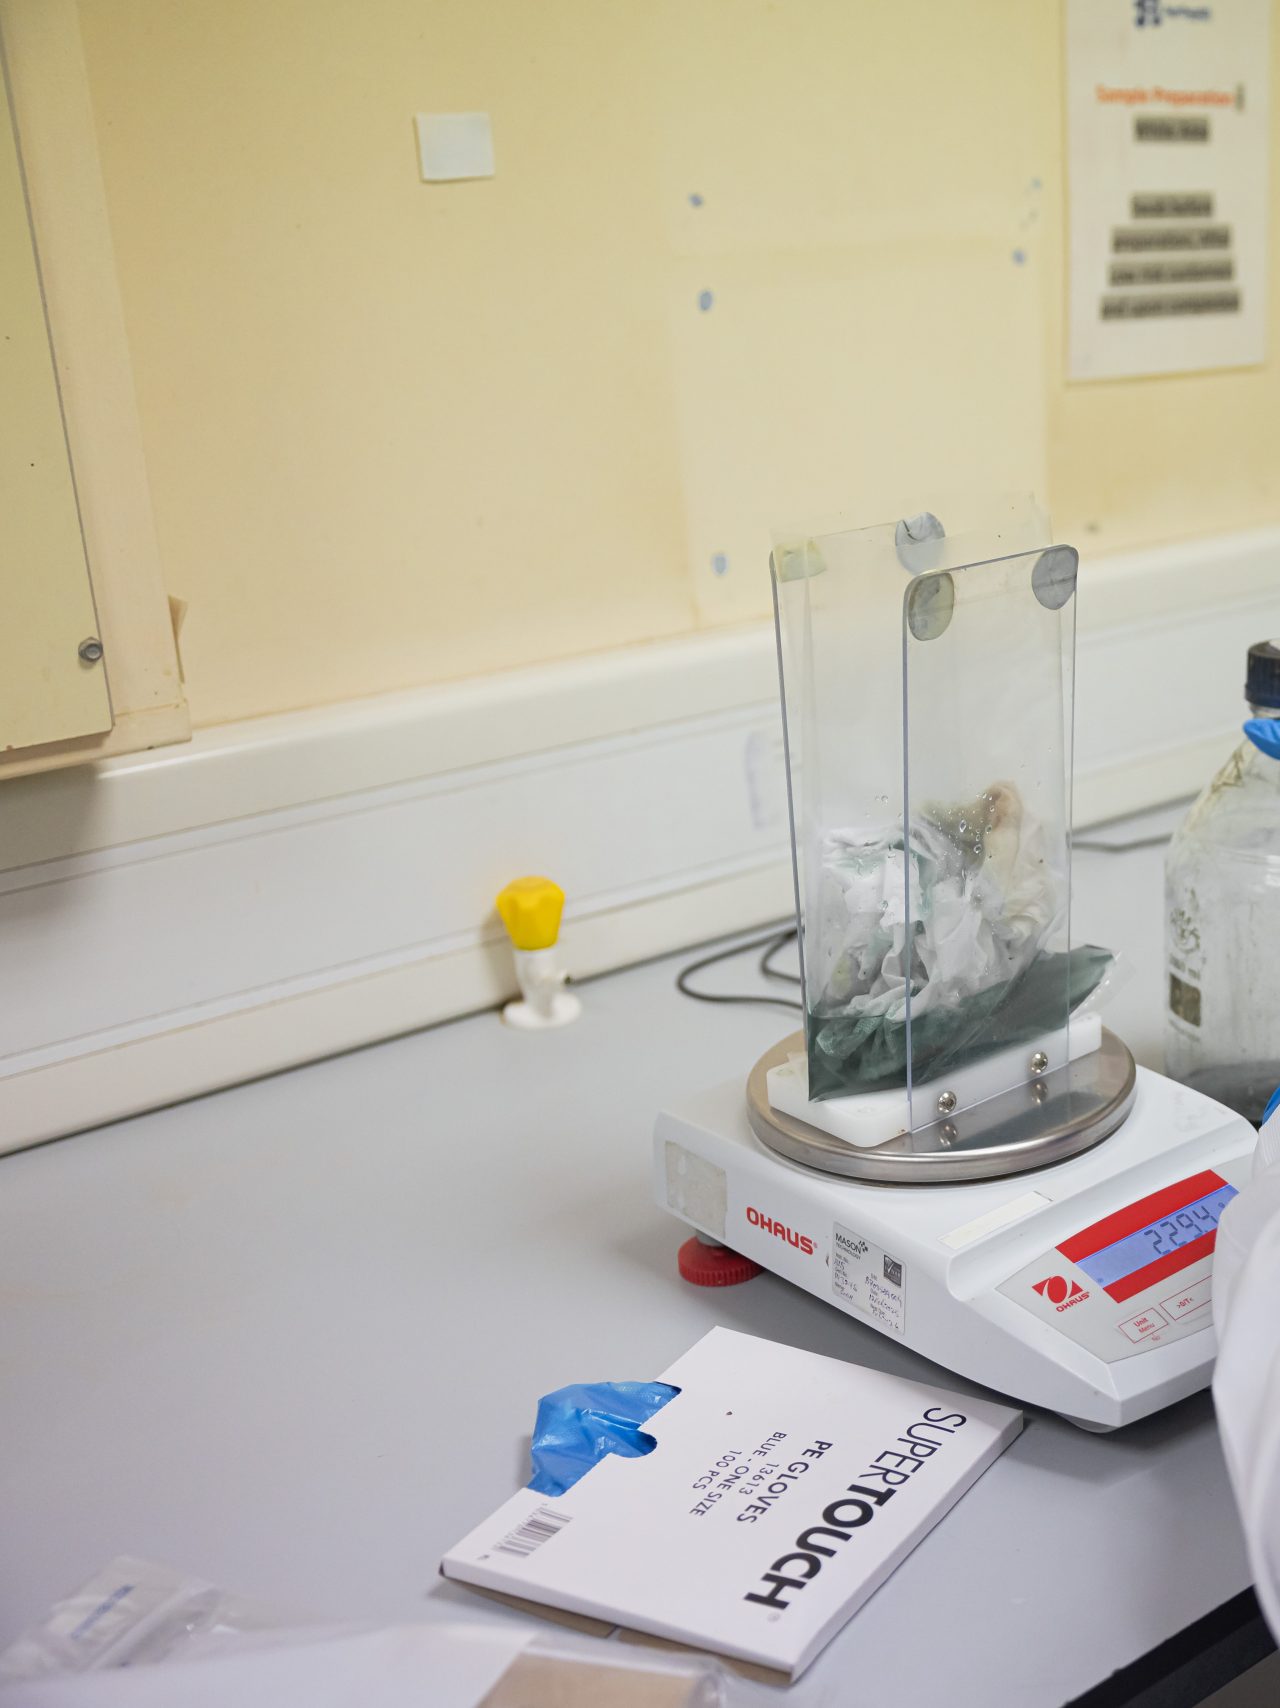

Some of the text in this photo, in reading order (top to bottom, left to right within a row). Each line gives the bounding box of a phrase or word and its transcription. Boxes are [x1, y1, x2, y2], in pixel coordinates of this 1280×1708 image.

[746, 1206, 813, 1255] OHAUS
[835, 1233, 861, 1254] MASON
[1056, 1292, 1089, 1313] OHAUS
[1133, 1317, 1149, 1327] Unit
[752, 1431, 787, 1457] BLUE
[692, 1450, 742, 1490] 100 PCS
[717, 1465, 750, 1490] ONE
[736, 1439, 833, 1524] PE GLOVES
[738, 1463, 780, 1496] 13613
[689, 1491, 723, 1517] SIZE
[743, 1407, 967, 1610] SUPERTOUCH
